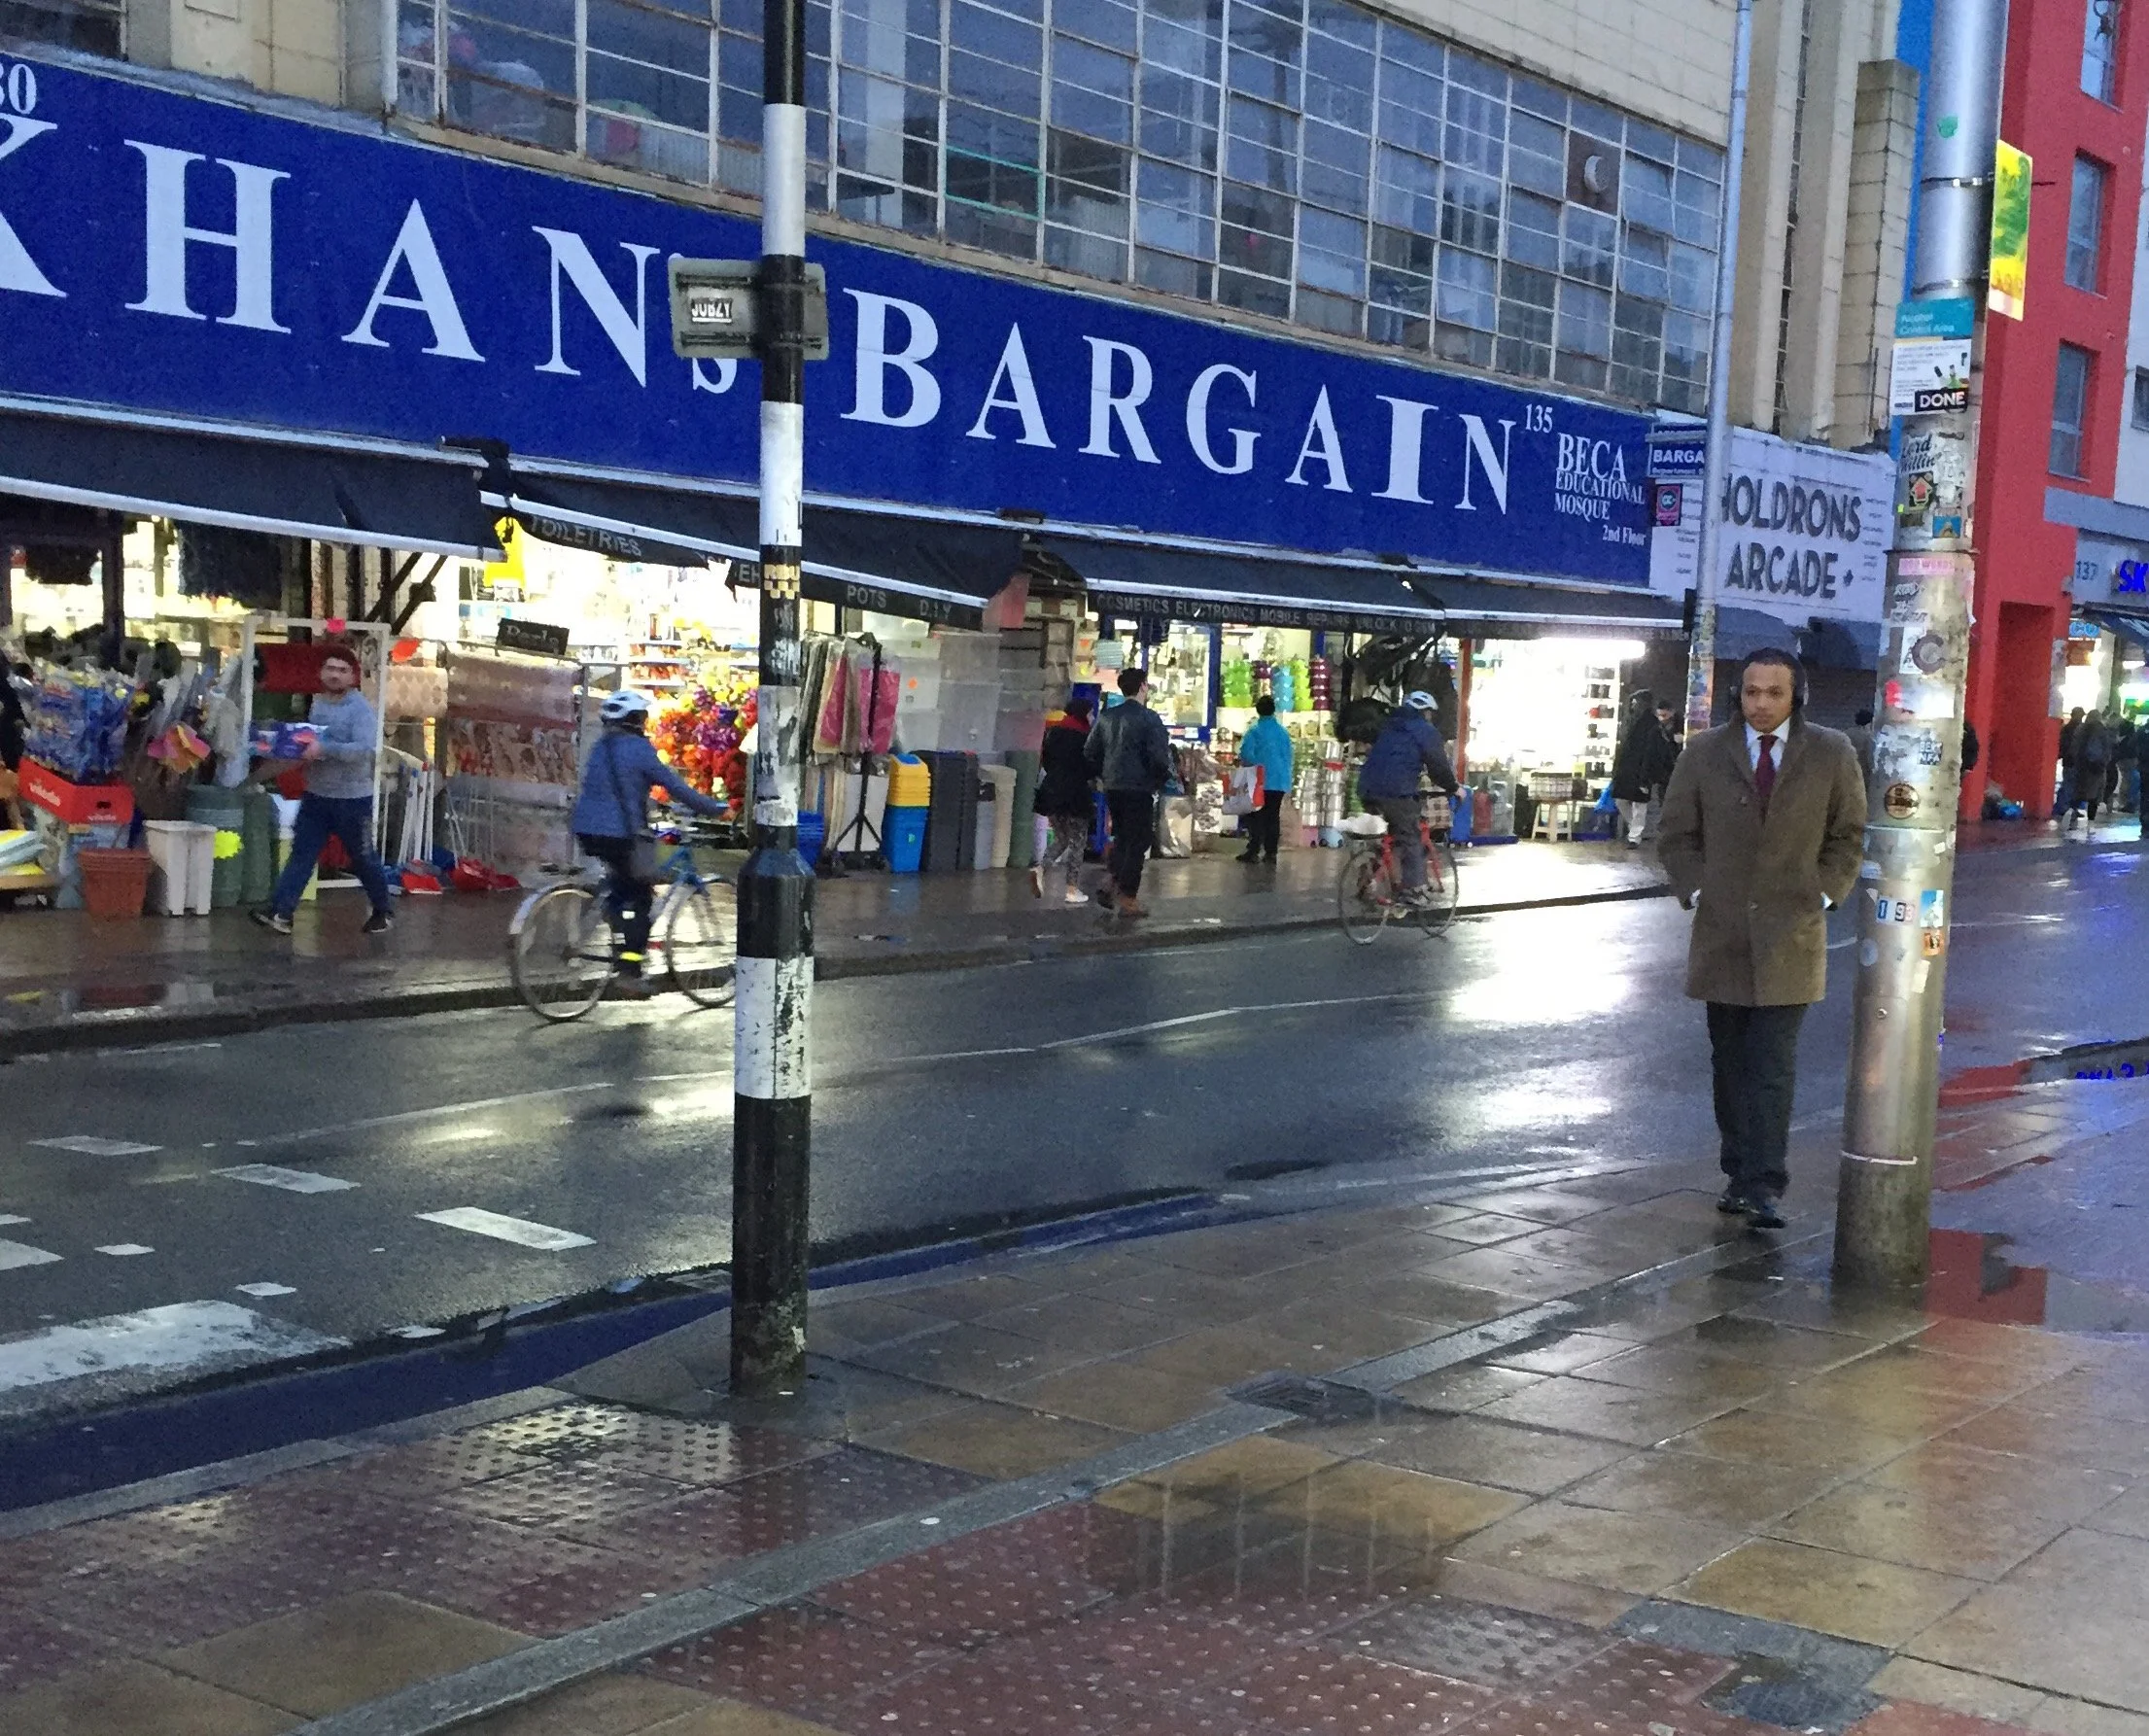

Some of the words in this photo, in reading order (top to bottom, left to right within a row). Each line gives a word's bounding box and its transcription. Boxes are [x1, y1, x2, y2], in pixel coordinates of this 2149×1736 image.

[0, 113, 738, 395] HAN
[840, 288, 1518, 516] BARGAIN
[1919, 391, 1966, 409] DONE
[1525, 403, 1553, 434] 135
[1556, 432, 1627, 483] BECA
[1652, 448, 1705, 465] BARGA
[1555, 469, 1646, 505] EDUCATIONAL
[1554, 492, 1612, 522] MOSQUE
[530, 515, 642, 558] TOILETRIES
[1602, 524, 1621, 542] 2nd
[1622, 526, 1647, 546] Floor
[1724, 540, 1839, 601] ARCADE
[2076, 560, 2097, 580] 137
[846, 584, 887, 609] POTS
[1096, 595, 1170, 615] COSMETICS
[1175, 600, 1256, 623] ELECTRONICS
[1260, 608, 1300, 626] MOBILE
